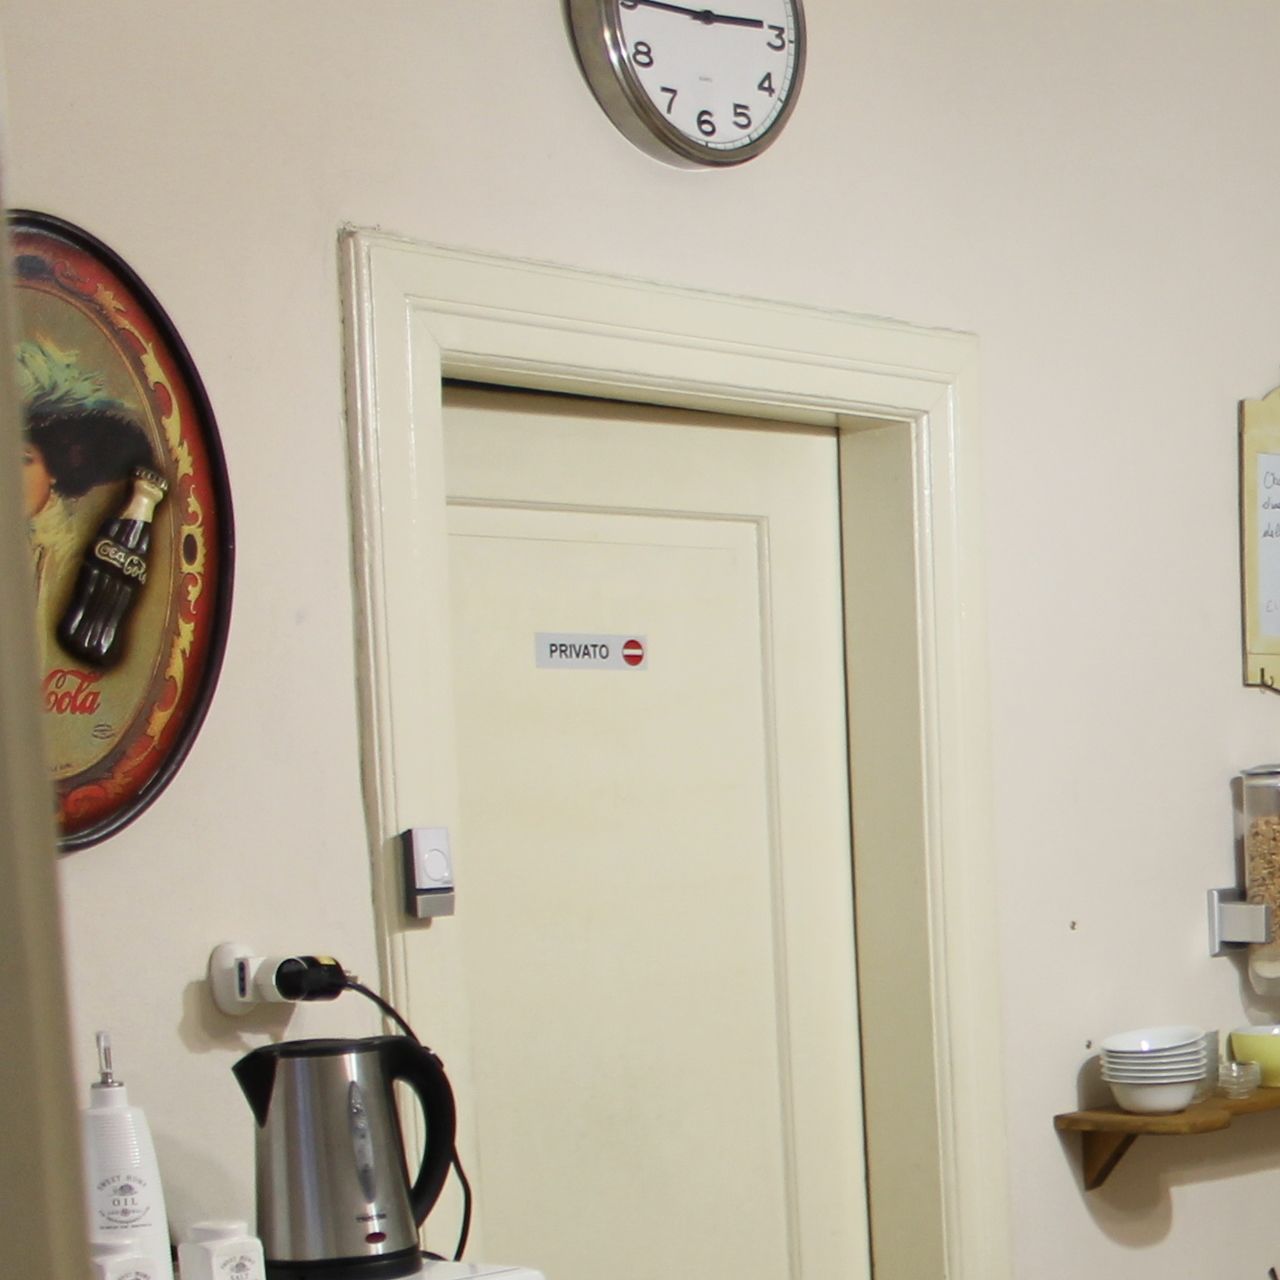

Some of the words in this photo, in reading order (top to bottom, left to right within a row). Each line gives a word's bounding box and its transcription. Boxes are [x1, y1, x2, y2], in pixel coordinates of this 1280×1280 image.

[766, 24, 786, 51] 3
[632, 41, 653, 68] 8
[757, 72, 775, 98] 4
[660, 86, 677, 115] 7
[697, 110, 716, 137] 6
[732, 103, 751, 130] 5
[549, 643, 610, 660] PRIVATO
[112, 1197, 139, 1207] OIL
